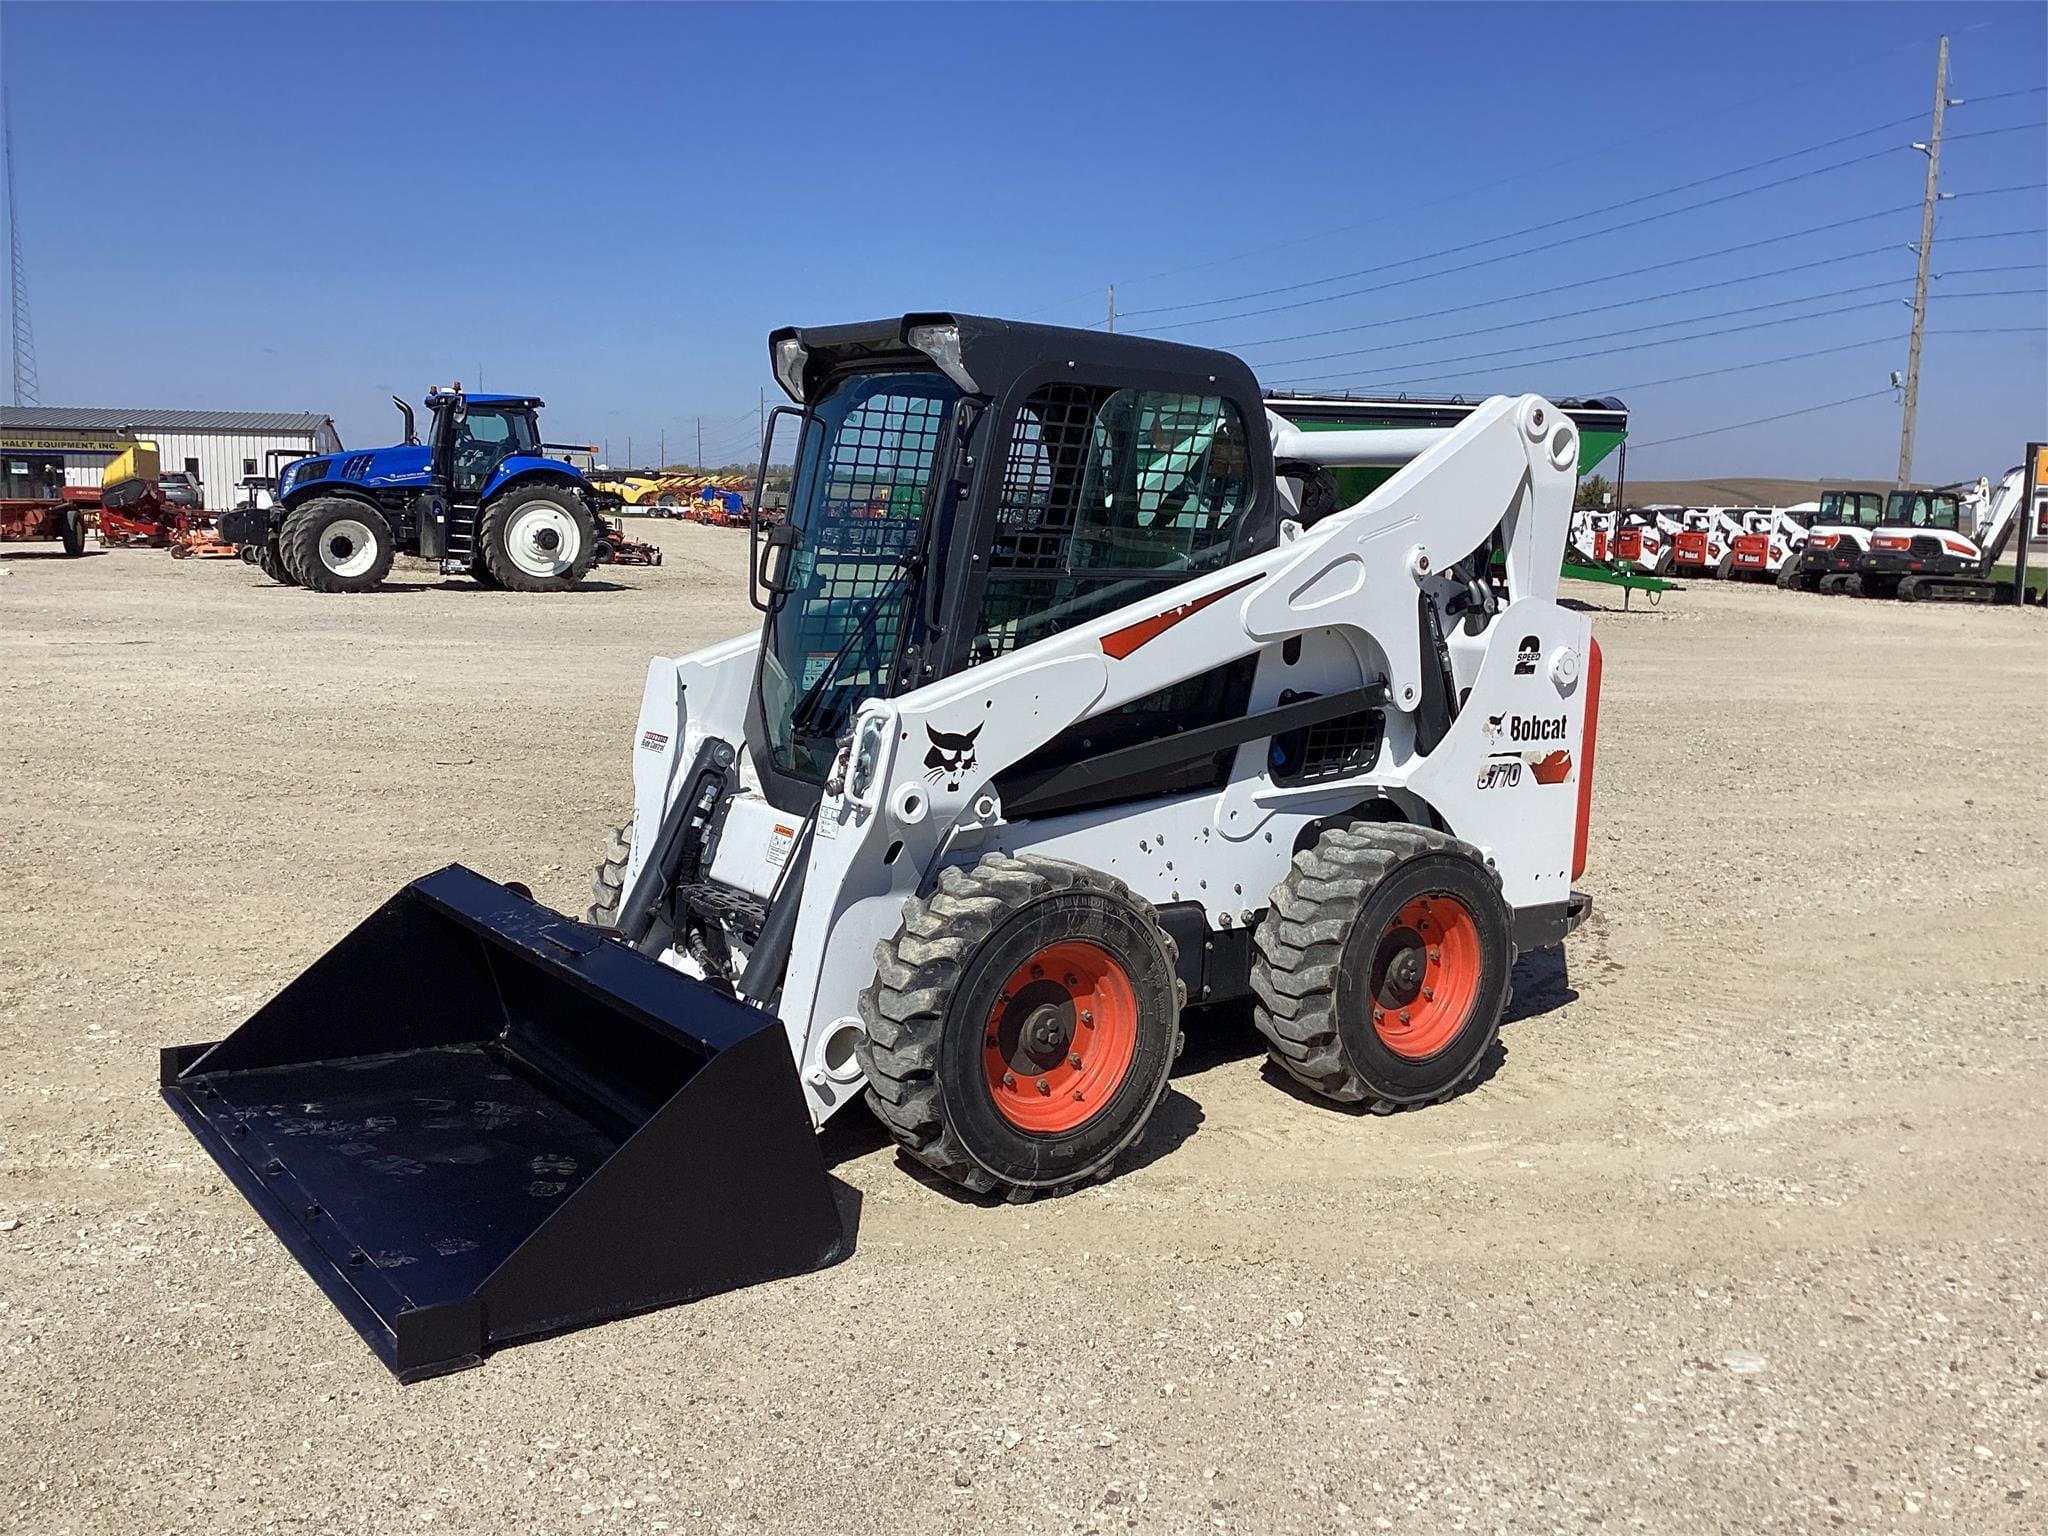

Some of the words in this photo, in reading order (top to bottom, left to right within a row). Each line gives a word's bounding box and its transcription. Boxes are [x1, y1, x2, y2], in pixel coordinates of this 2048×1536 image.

[1, 440, 34, 448] HALEY
[37, 441, 97, 449] EQUIPMENT,
[1514, 636, 1540, 674] 2
[1517, 653, 1541, 661] SPEED
[1510, 714, 1567, 741] Bobcat
